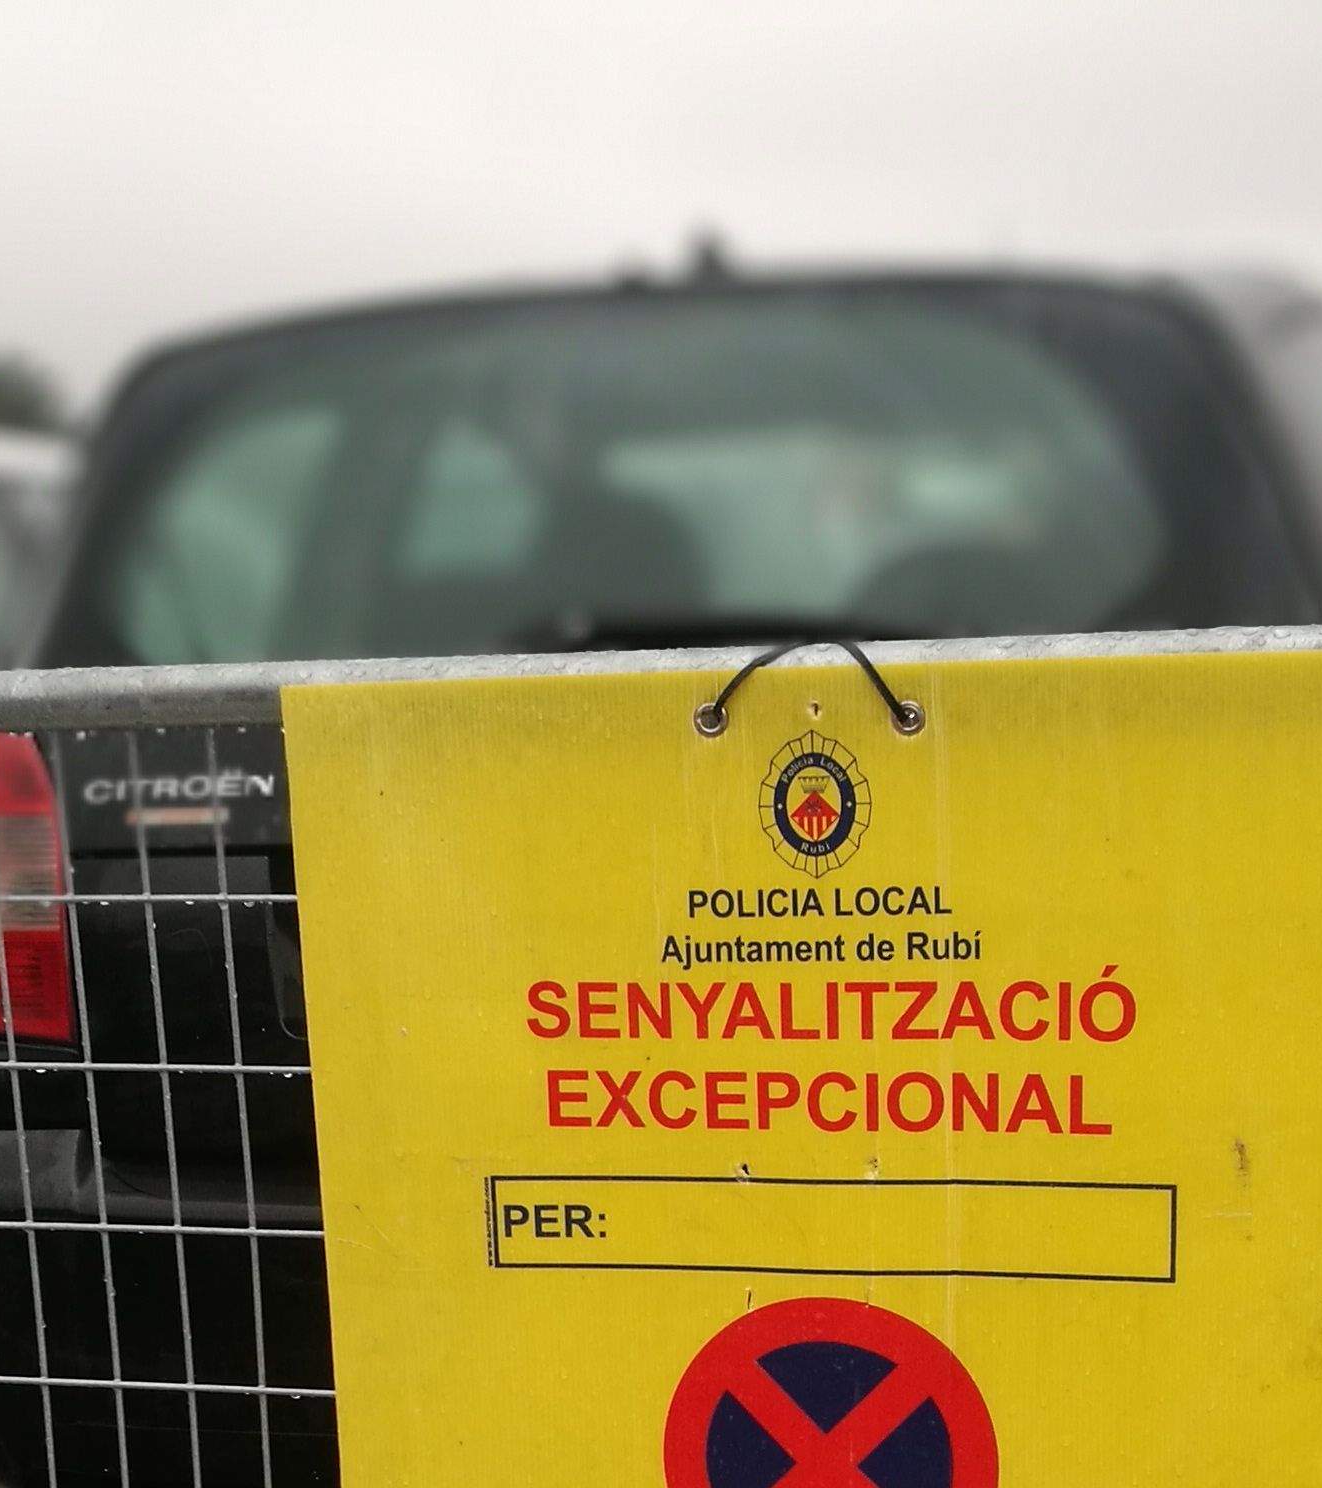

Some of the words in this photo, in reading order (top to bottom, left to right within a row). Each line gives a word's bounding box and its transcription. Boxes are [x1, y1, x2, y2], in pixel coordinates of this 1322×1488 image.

[688, 887, 825, 918] POLICIA
[834, 885, 952, 917] LOCAL
[661, 934, 845, 970] Ajuntament
[856, 932, 895, 961] de
[906, 930, 981, 961] Rubí
[526, 964, 1137, 1043] SENYALITZACIÓ
[546, 1069, 1113, 1136] EXCEPCIONAL
[503, 1204, 606, 1238] PER:
